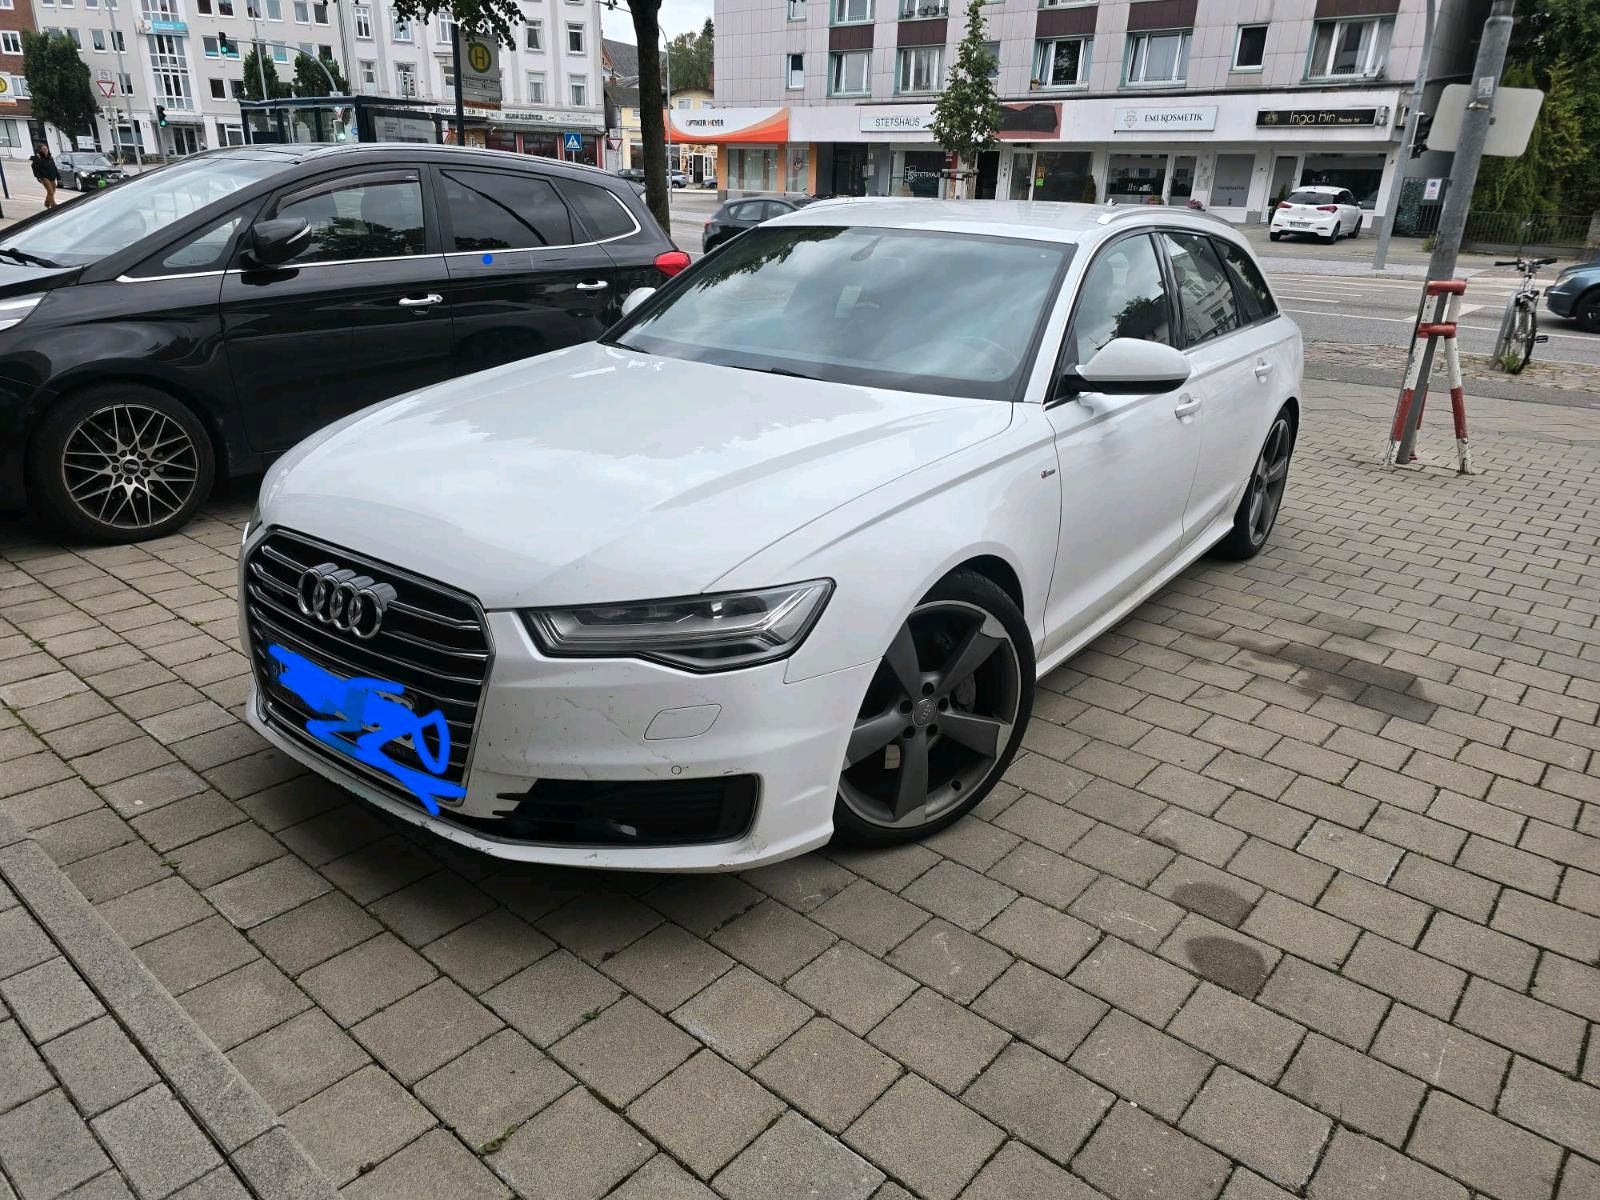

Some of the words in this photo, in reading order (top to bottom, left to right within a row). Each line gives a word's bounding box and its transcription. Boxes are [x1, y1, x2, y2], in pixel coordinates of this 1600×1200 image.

[474, 47, 486, 67] H
[685, 119, 707, 127] OPTIKER
[875, 117, 921, 127] STETSHAUS
[1144, 114, 1160, 122] EMI
[1160, 113, 1203, 123] KOSMETIK
[1289, 111, 1315, 125] Inga
